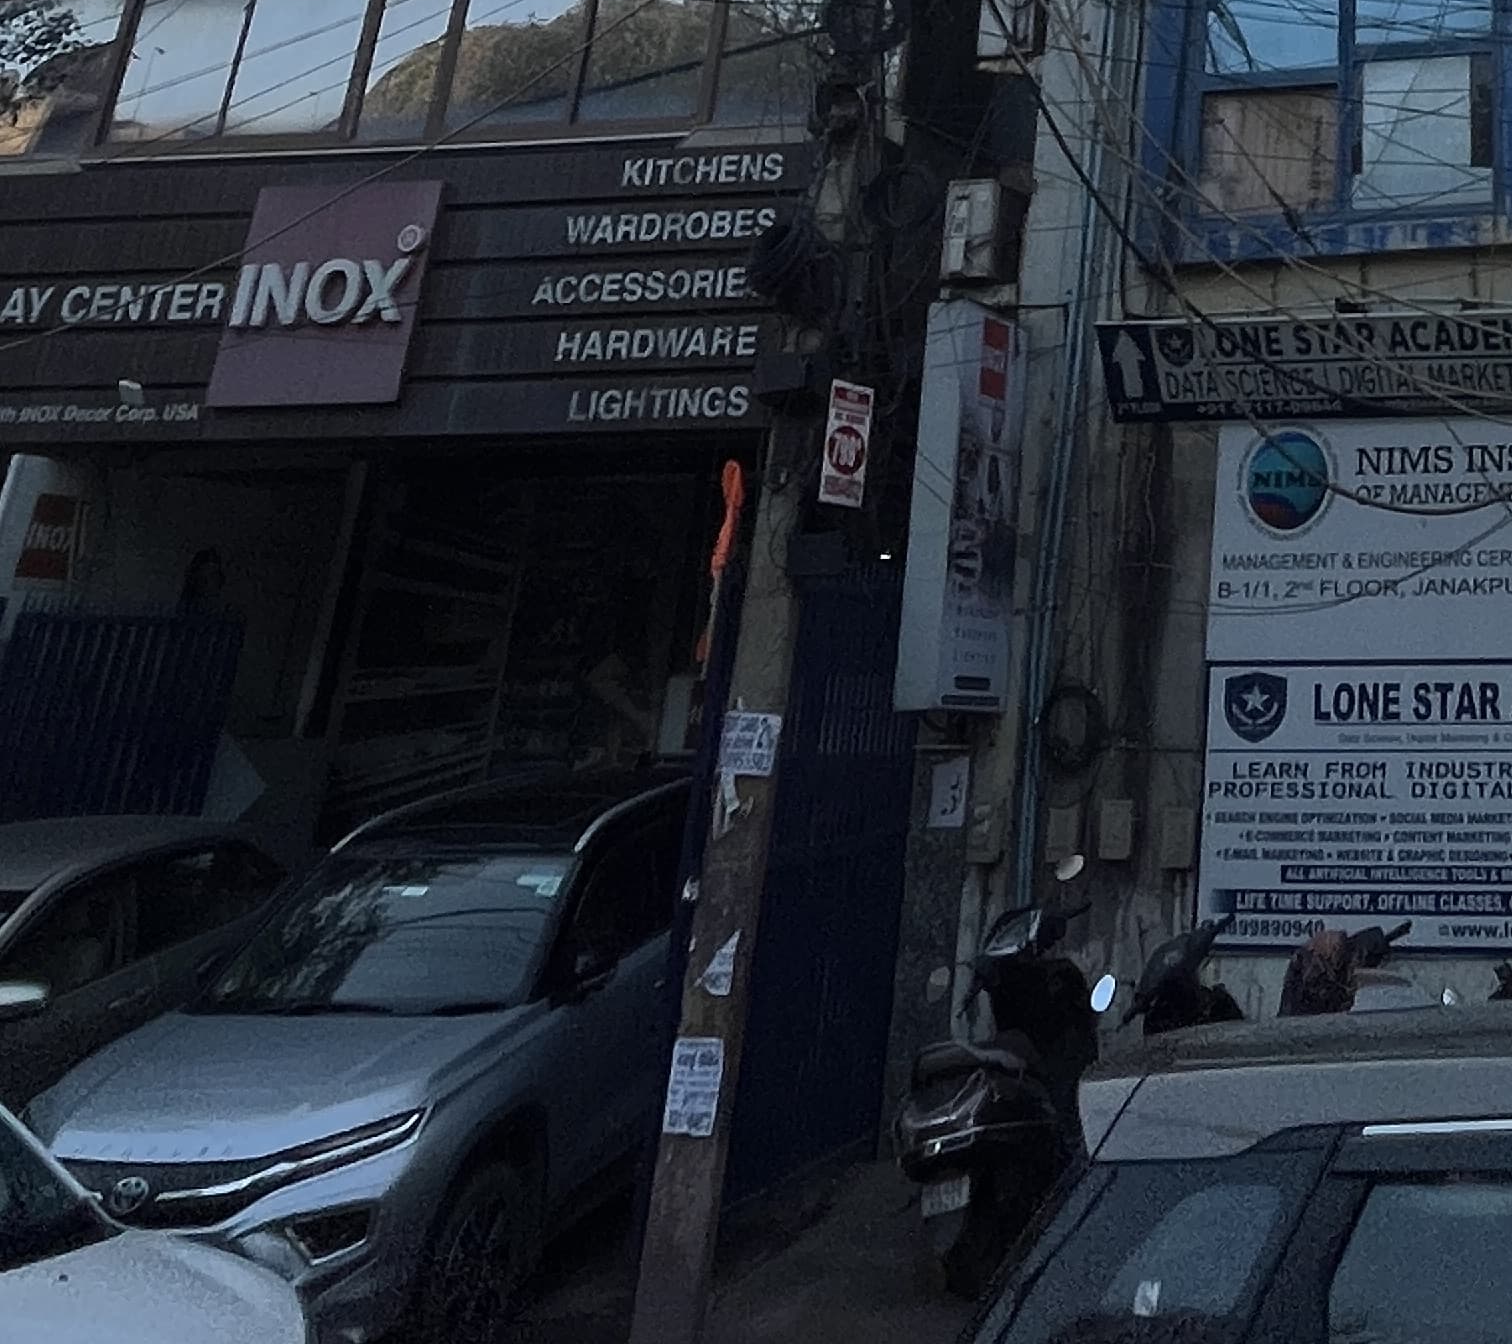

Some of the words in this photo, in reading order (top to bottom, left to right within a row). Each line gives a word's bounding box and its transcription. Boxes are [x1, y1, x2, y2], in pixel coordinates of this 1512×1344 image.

[621, 153, 784, 187] KITCHENS
[566, 207, 777, 243] WARDROBES
[61, 283, 224, 323] CENTER
[229, 257, 410, 329] INOX
[553, 325, 758, 361] HARDWARE
[1293, 324, 1374, 354] STAR
[1165, 370, 1219, 400] DATA
[1225, 366, 1316, 400] SCIENCE
[163, 404, 198, 421] USA
[568, 386, 750, 422] LIGHTINGS
[1356, 446, 1453, 476] NIMS
[1222, 553, 1338, 571] MANAGEMENT
[1342, 553, 1353, 569] &
[1355, 550, 1471, 569] ENGINEERING
[1313, 681, 1400, 720] LONE
[1412, 681, 1500, 720] STAR
[1232, 761, 1308, 778] LEARN
[1325, 761, 1387, 778] FROM
[1208, 782, 1393, 799] PROFESSIONAL
[1236, 892, 1266, 910] LIFE
[1270, 892, 1301, 910] TIME
[1377, 893, 1436, 911] OFFLINE
